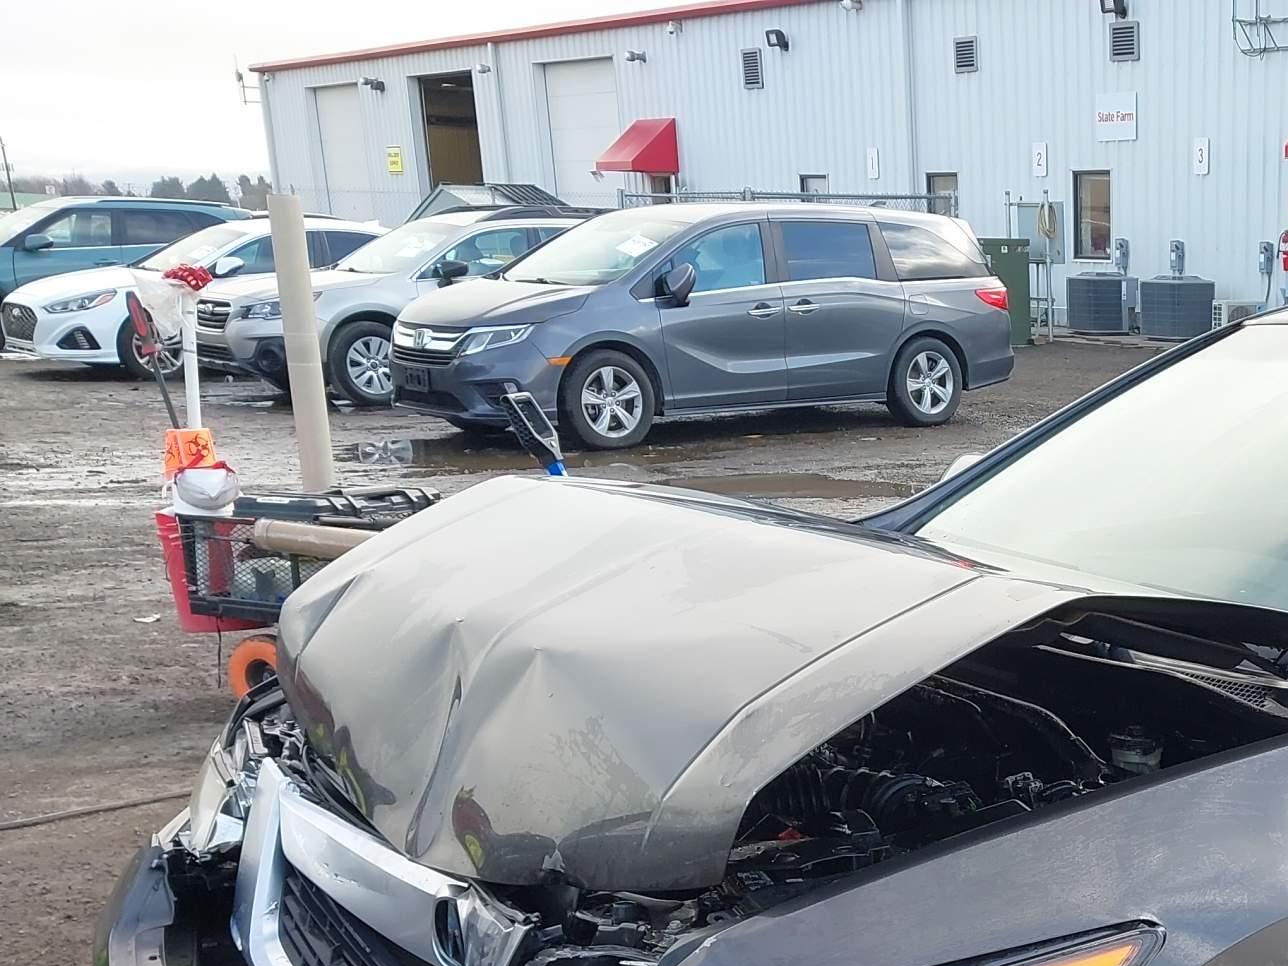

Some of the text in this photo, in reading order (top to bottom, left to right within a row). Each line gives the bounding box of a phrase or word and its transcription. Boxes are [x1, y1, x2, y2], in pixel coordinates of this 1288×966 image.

[1097, 110, 1134, 122] State Farm
[1036, 151, 1042, 167] 2
[1198, 147, 1204, 164] 3
